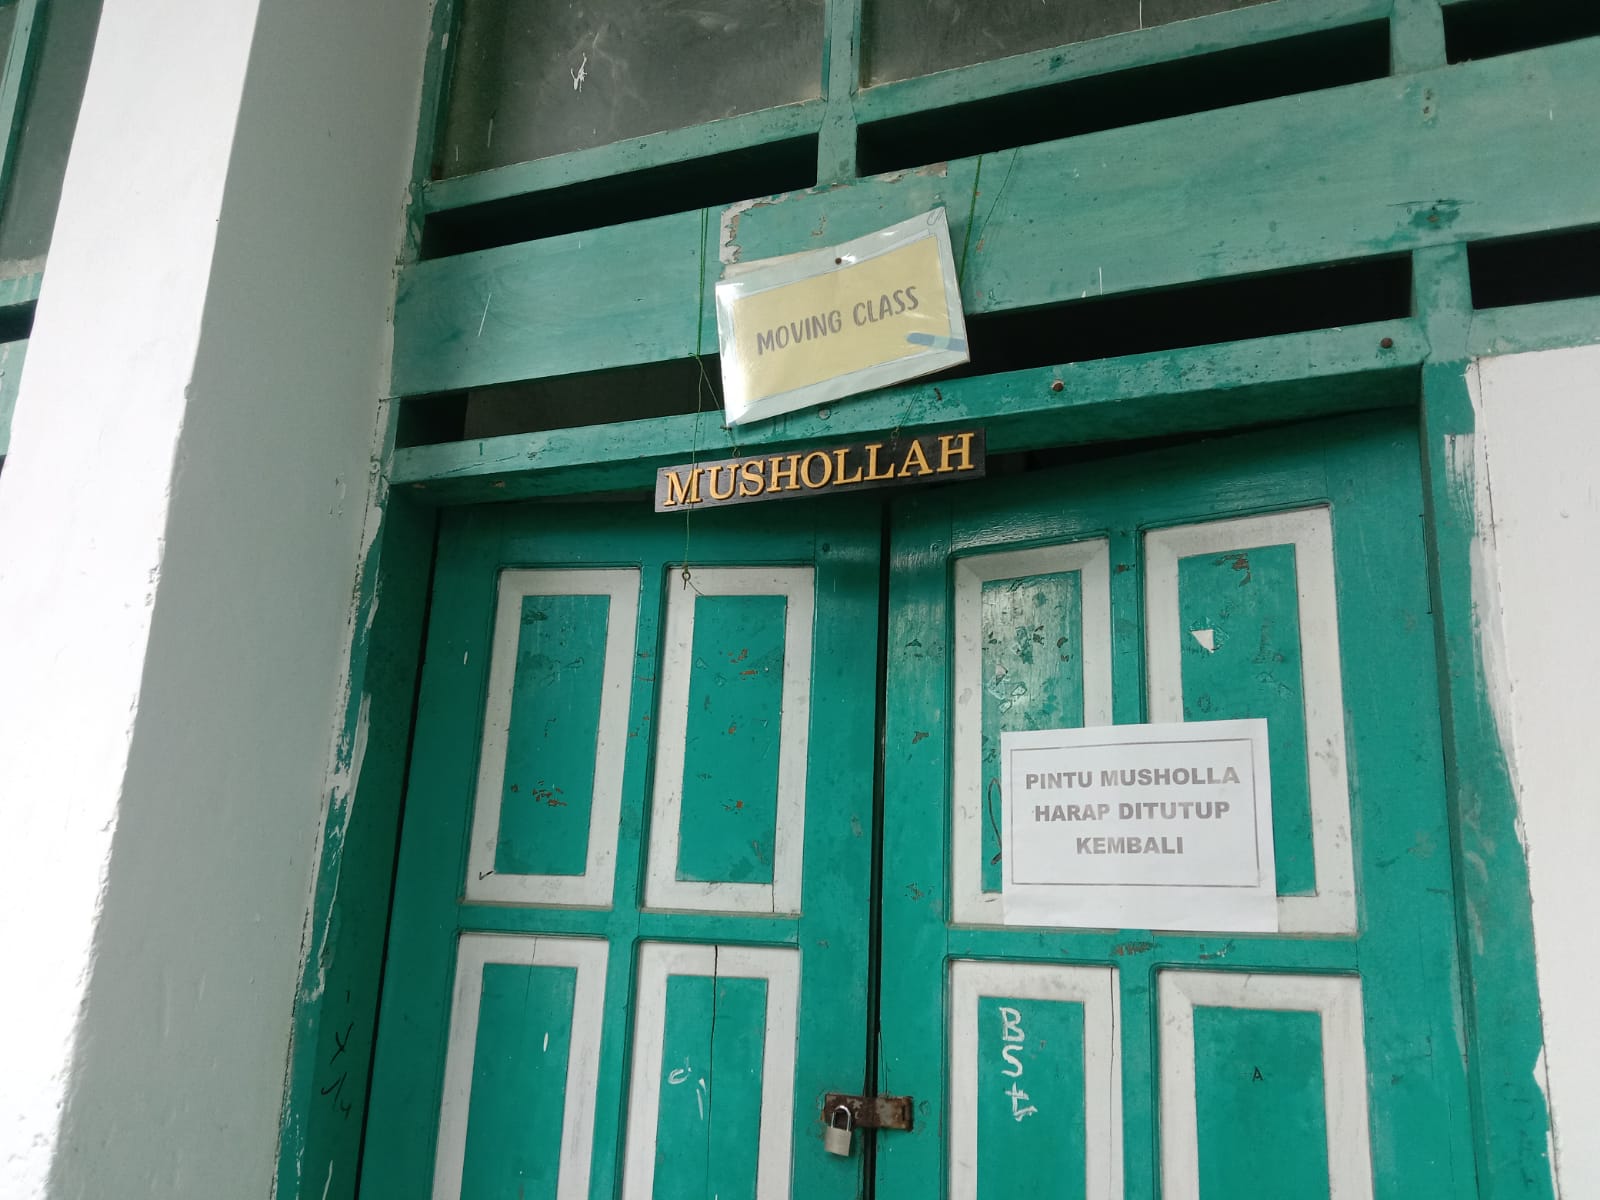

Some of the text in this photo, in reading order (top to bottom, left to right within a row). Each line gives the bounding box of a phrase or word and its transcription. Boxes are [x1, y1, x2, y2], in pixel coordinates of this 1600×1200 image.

[757, 286, 920, 355] MOVING CLASS
[663, 432, 976, 507] MUSHOLLAH
[1025, 766, 1241, 790] PINTU MUSHOLLA
[1034, 801, 1231, 822] HARAP DITUTUP
[1076, 836, 1184, 855] KEMBALI
